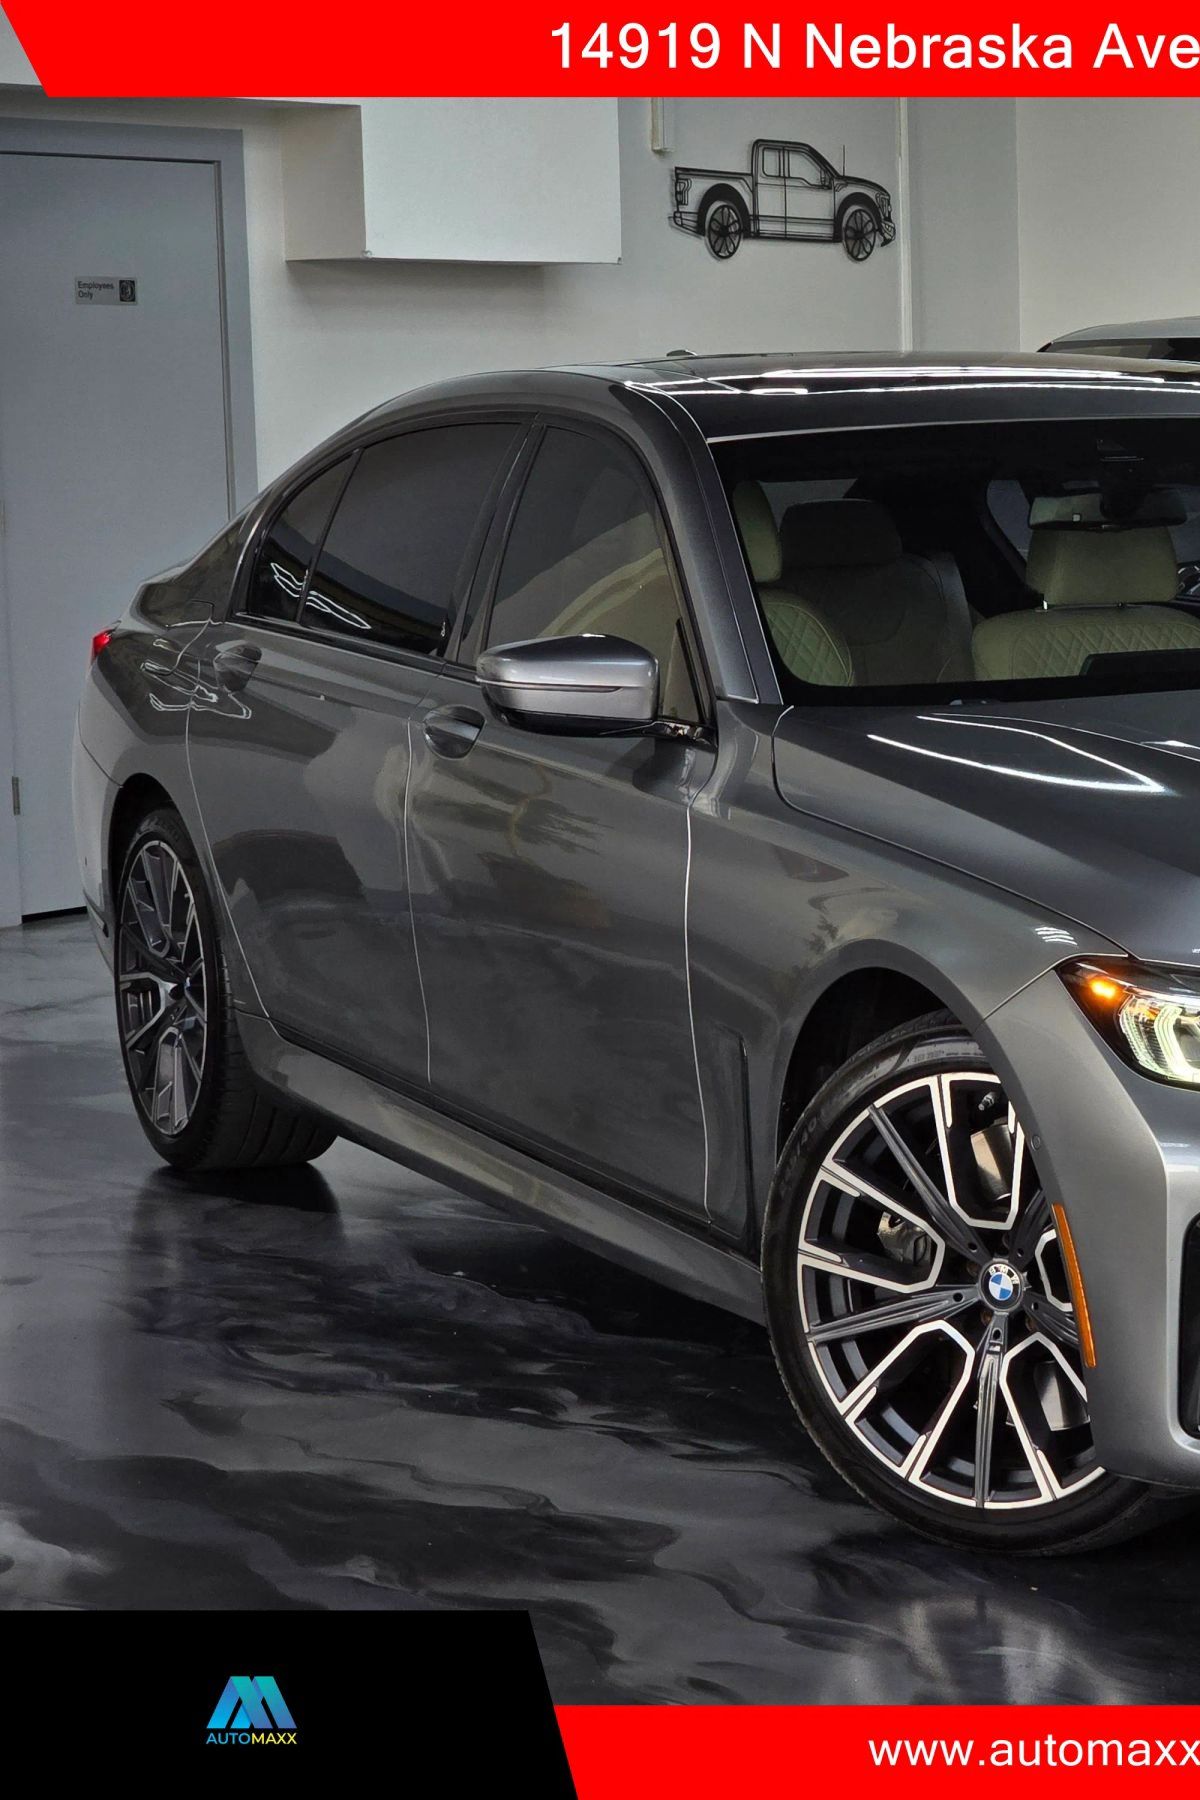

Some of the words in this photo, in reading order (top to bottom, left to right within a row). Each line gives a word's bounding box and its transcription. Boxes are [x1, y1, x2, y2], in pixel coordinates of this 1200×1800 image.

[77, 280, 114, 291] Employees
[78, 290, 94, 300] Only
[988, 1263, 1020, 1285] BMW
